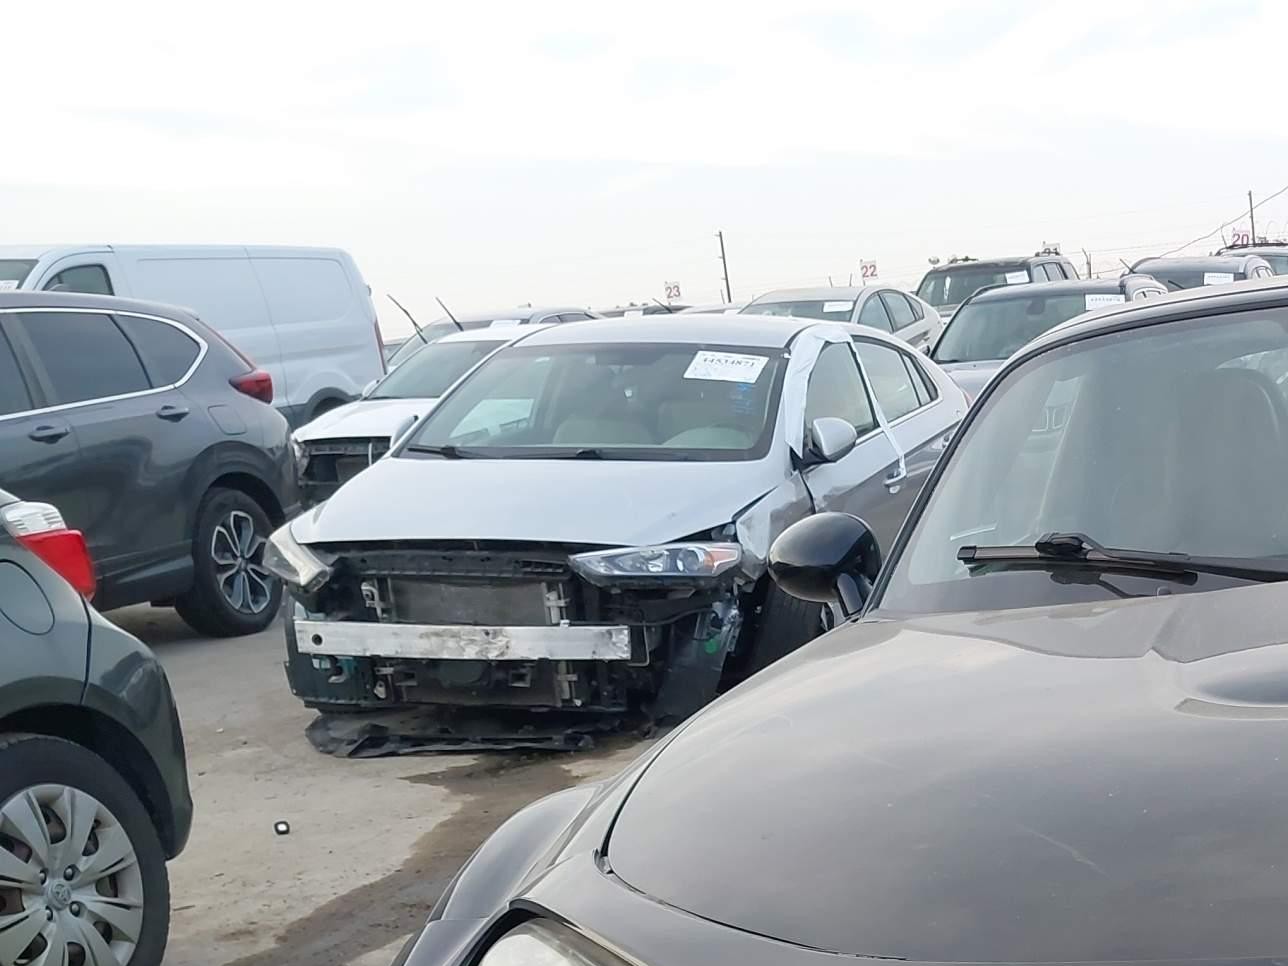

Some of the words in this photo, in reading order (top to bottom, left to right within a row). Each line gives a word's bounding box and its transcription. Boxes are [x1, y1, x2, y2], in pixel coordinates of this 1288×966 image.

[1232, 233, 1249, 247] 20
[860, 264, 878, 278] 22
[665, 285, 681, 299] 23
